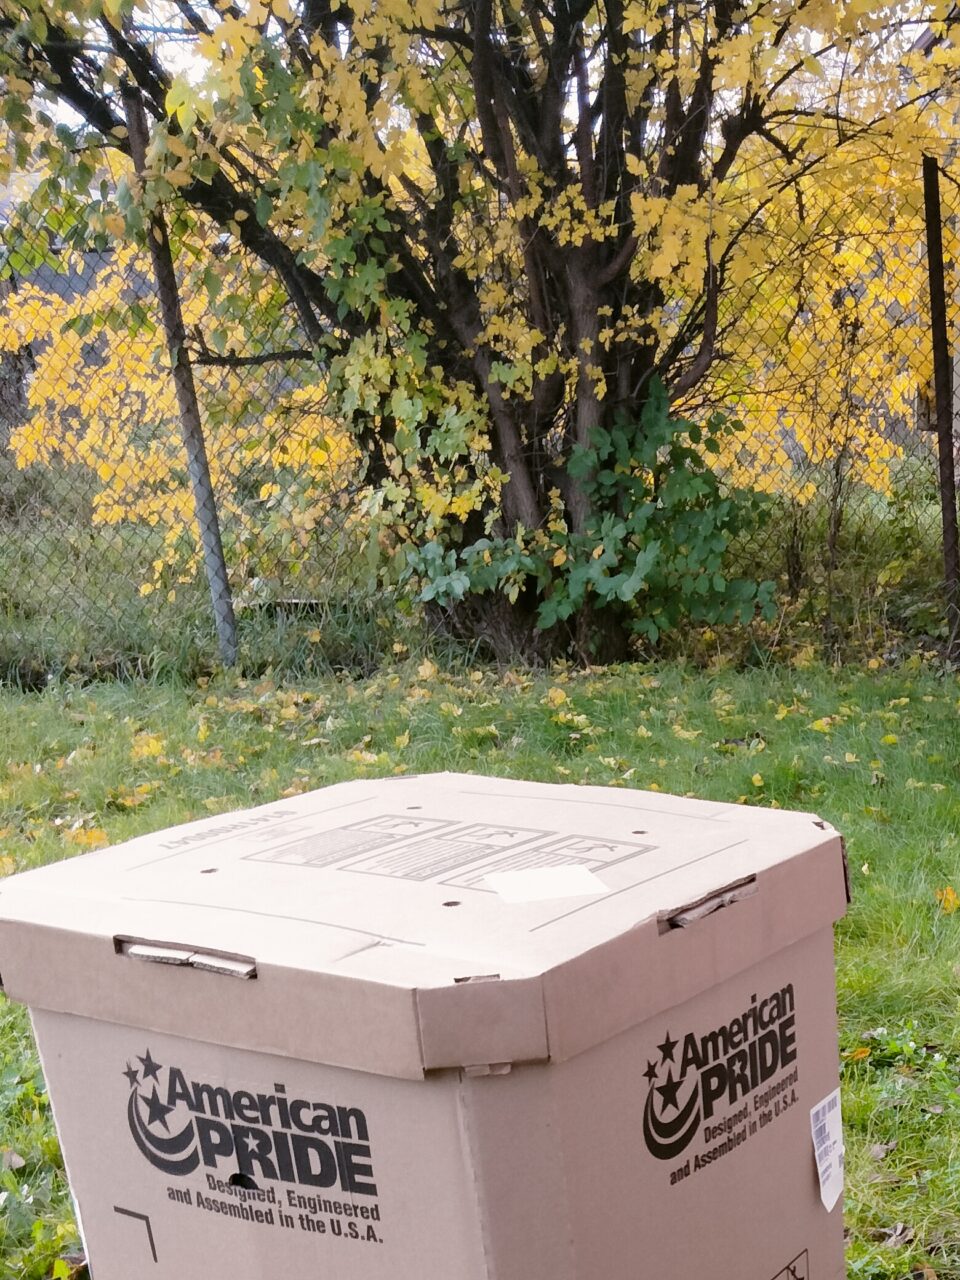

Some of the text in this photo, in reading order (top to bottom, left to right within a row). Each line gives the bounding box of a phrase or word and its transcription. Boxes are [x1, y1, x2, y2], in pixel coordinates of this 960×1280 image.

[680, 982, 795, 1081] American
[701, 1013, 797, 1121] PRIDE
[167, 1065, 370, 1142] American
[669, 1088, 799, 1186] and Assembled in the U.S.A.
[704, 1066, 798, 1144] Designed, Engineered
[194, 1115, 379, 1197] PRIDE
[167, 1186, 384, 1244] and Assembled in the U.S.A.
[286, 1188, 381, 1222] Engineered
